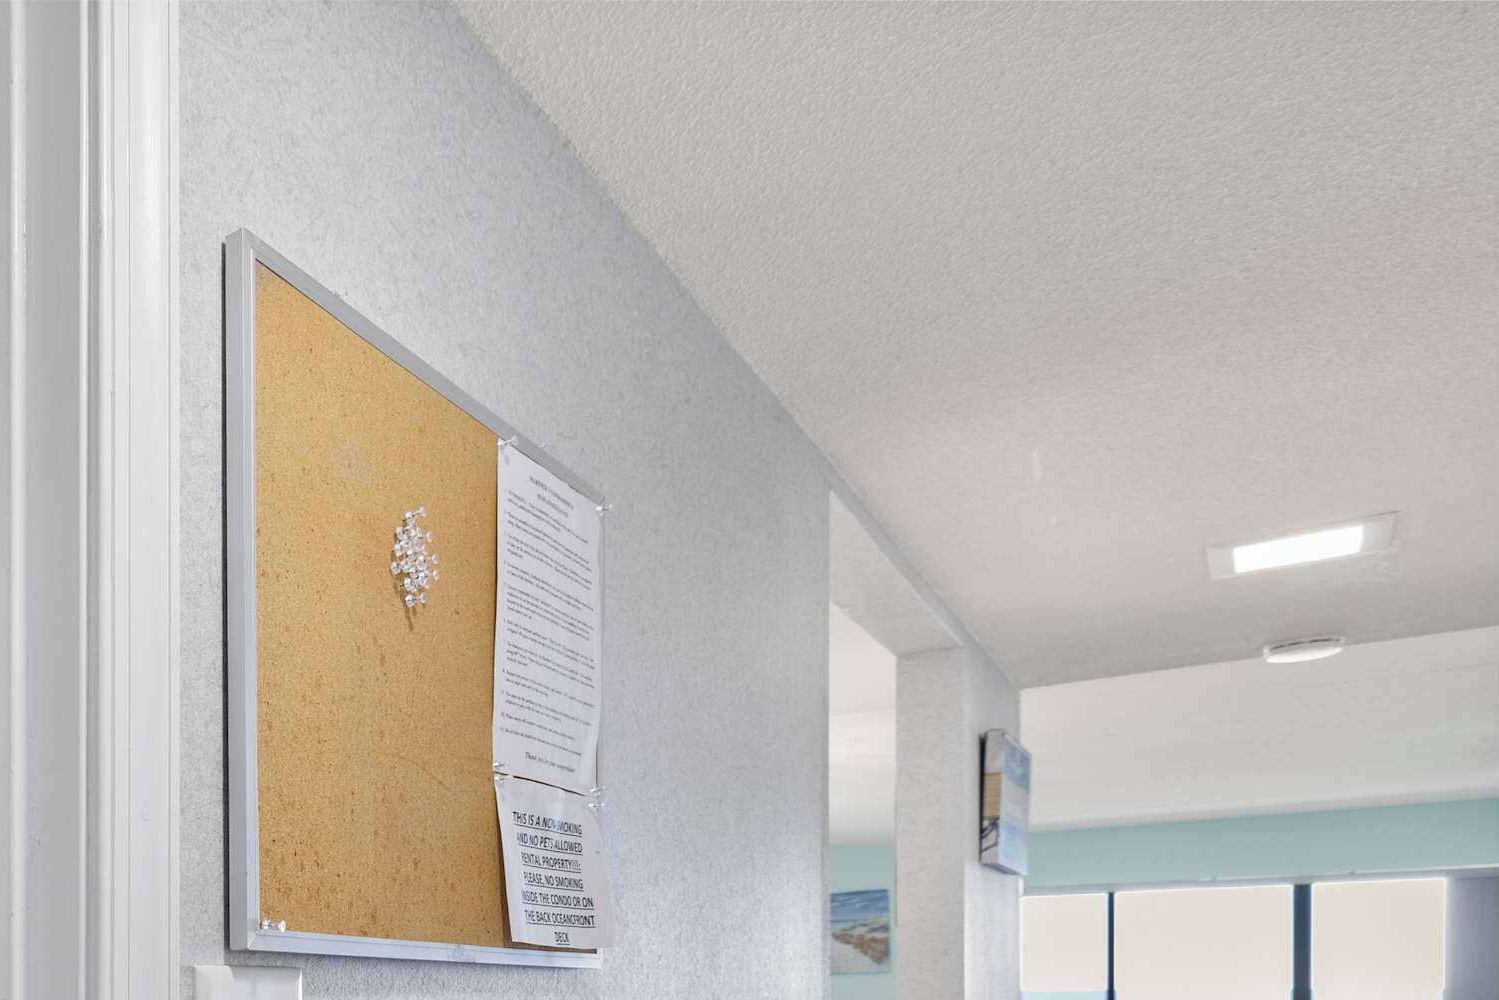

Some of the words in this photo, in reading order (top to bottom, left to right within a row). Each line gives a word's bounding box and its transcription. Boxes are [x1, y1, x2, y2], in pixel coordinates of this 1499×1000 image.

[513, 811, 527, 825] THIS
[528, 814, 535, 826] IS
[535, 816, 541, 826] A
[517, 832, 528, 844] AND
[529, 835, 538, 846] NO
[539, 836, 554, 849] PETS
[554, 838, 583, 853] ALLOWED
[521, 852, 542, 866] RENTAL
[545, 875, 554, 886] NO
[555, 876, 584, 890] SMOKING
[521, 890, 539, 903] INSIDE
[539, 892, 550, 904] THE
[550, 894, 572, 907] CONDO
[572, 896, 581, 907] OR
[582, 897, 594, 908] ON
[524, 909, 535, 922] THE
[536, 911, 551, 923] BACK
[554, 931, 570, 943] DECK
